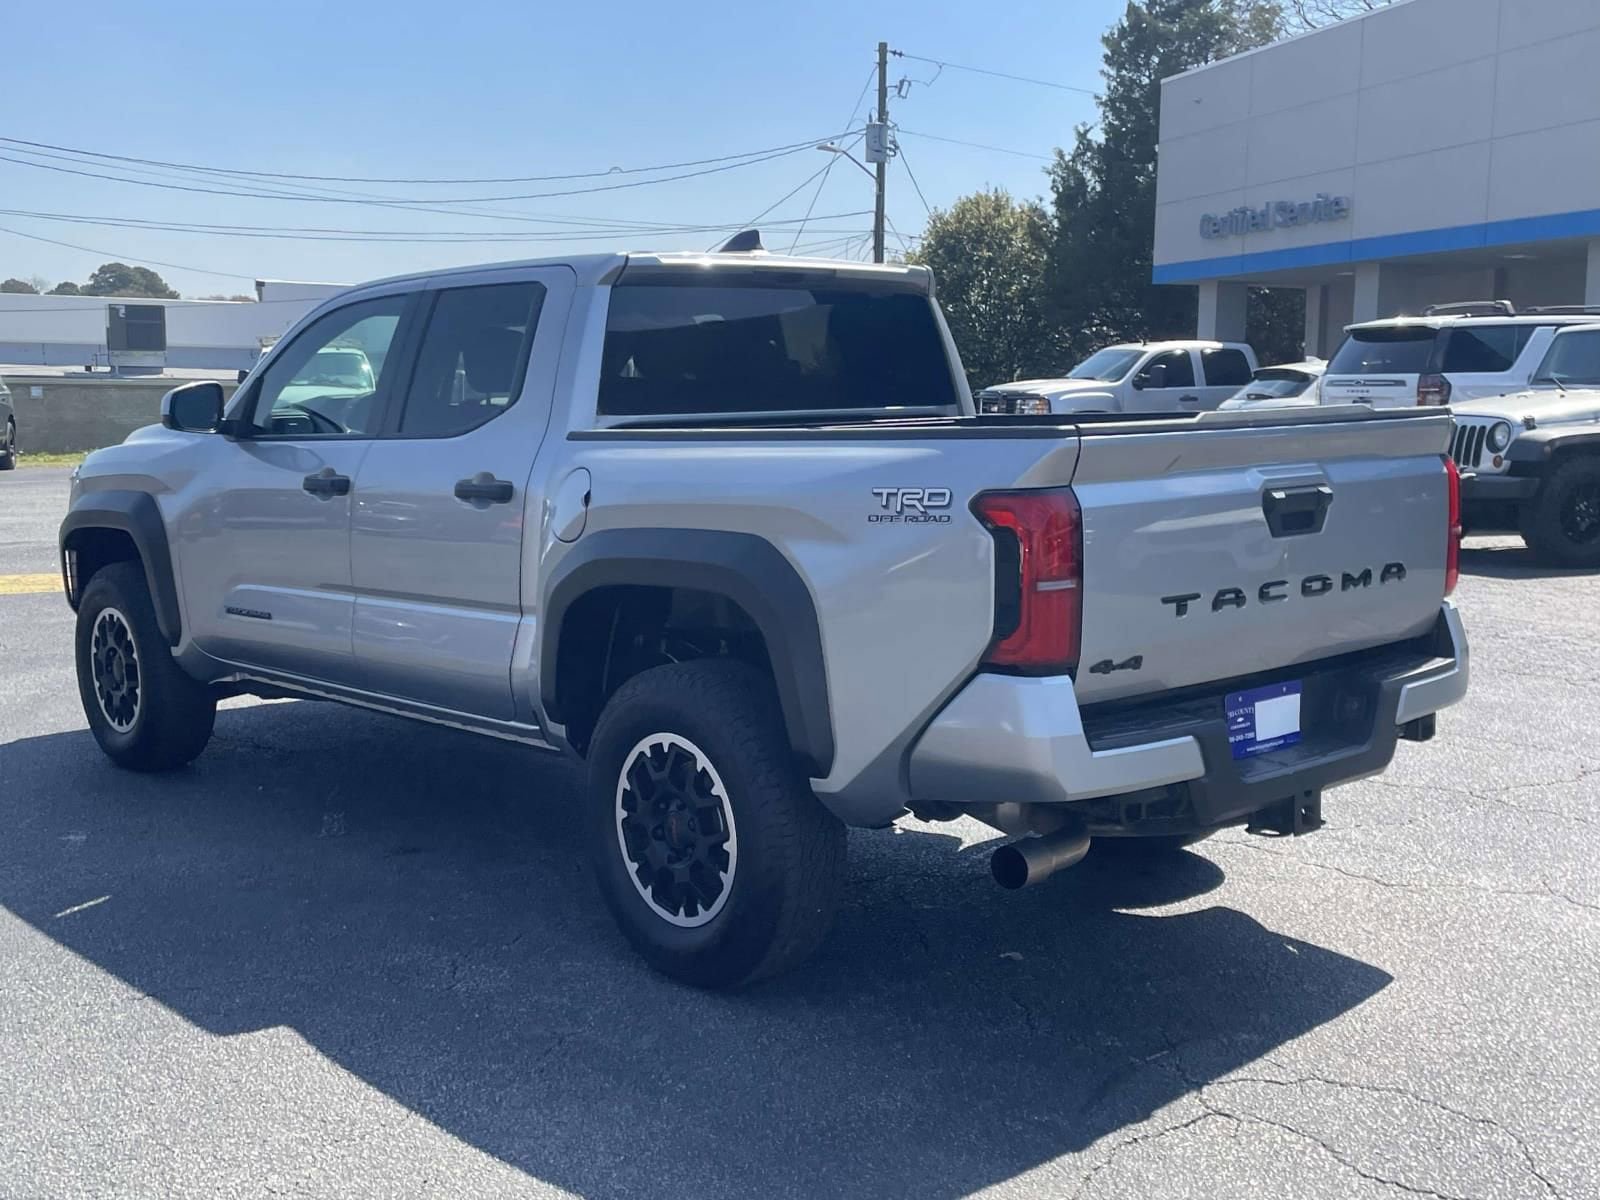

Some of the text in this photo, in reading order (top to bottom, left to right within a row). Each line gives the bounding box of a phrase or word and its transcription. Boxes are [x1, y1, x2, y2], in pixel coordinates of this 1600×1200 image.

[1200, 194, 1350, 239] Certified Service
[872, 487, 953, 513] TRD
[868, 515, 951, 523] OFF ROAD
[1161, 562, 1407, 618] TACOMA
